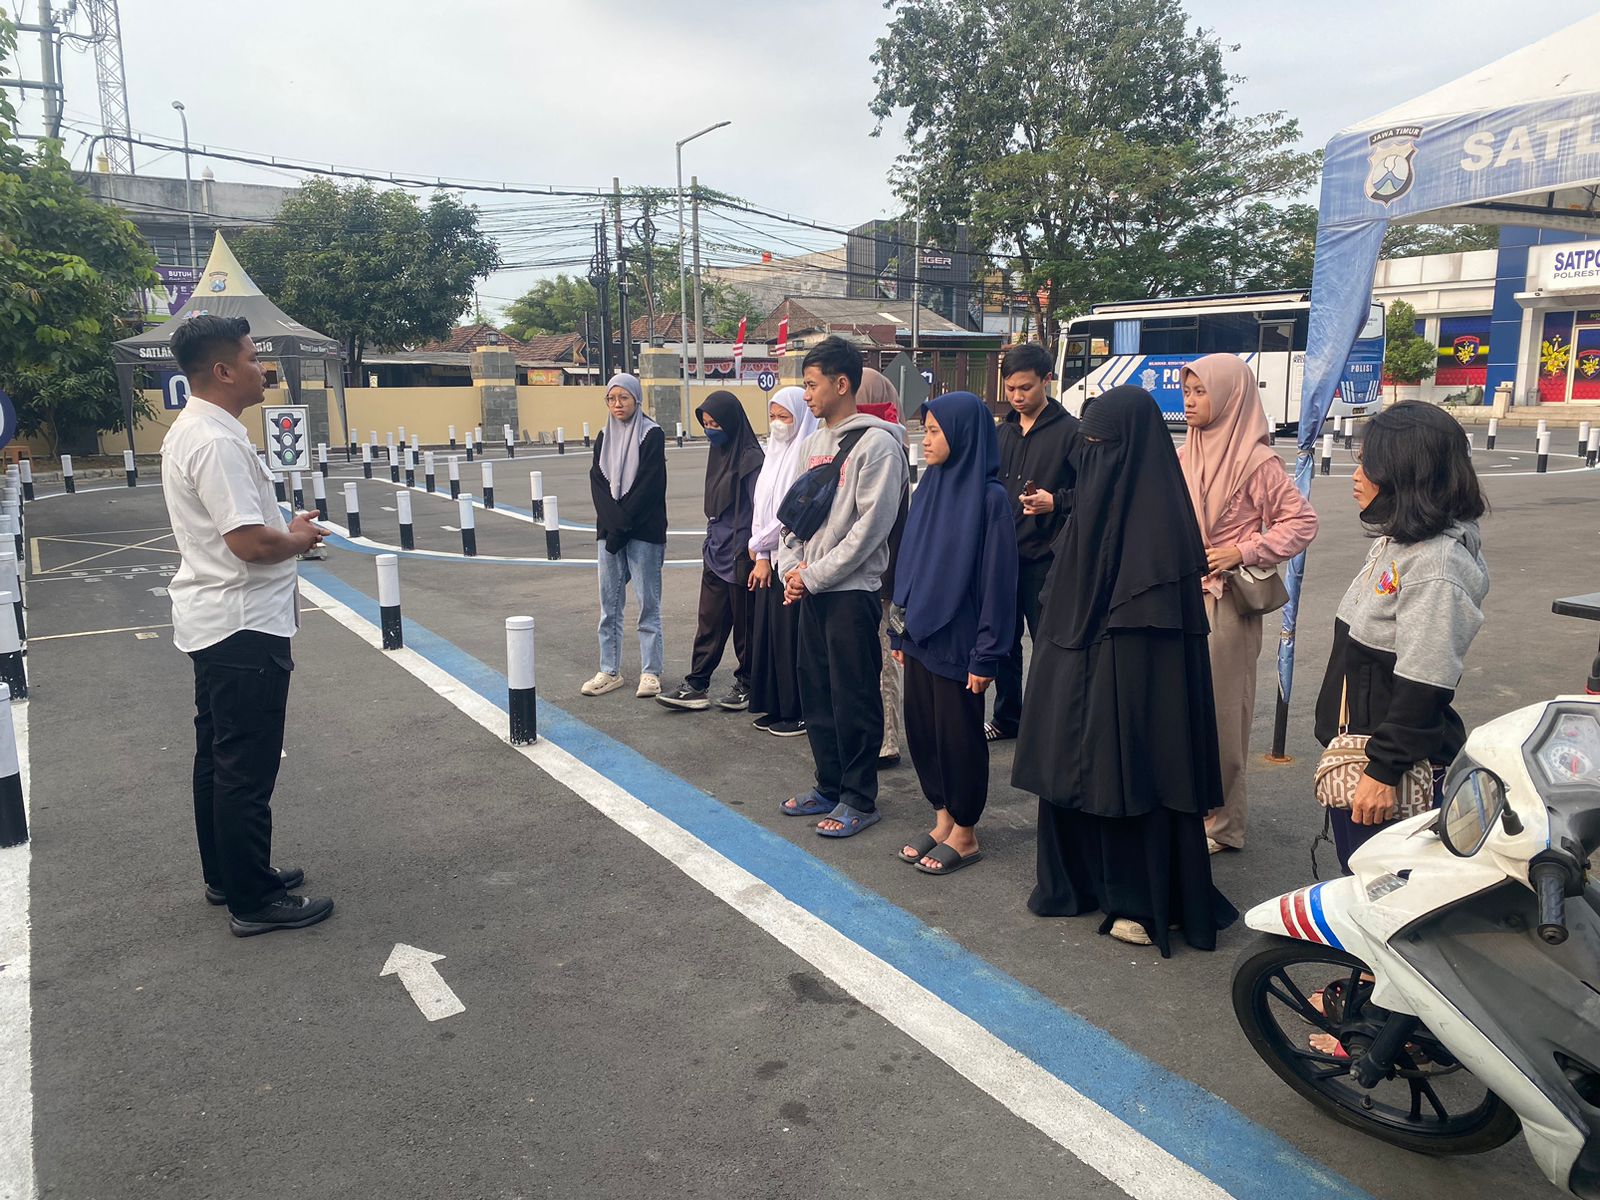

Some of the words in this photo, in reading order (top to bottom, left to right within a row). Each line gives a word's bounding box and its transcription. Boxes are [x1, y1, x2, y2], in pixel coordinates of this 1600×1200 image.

[1372, 130, 1394, 142] JAWA
[1351, 364, 1373, 373] POLISI
[760, 374, 774, 388] 30
[1163, 368, 1180, 383] PO
